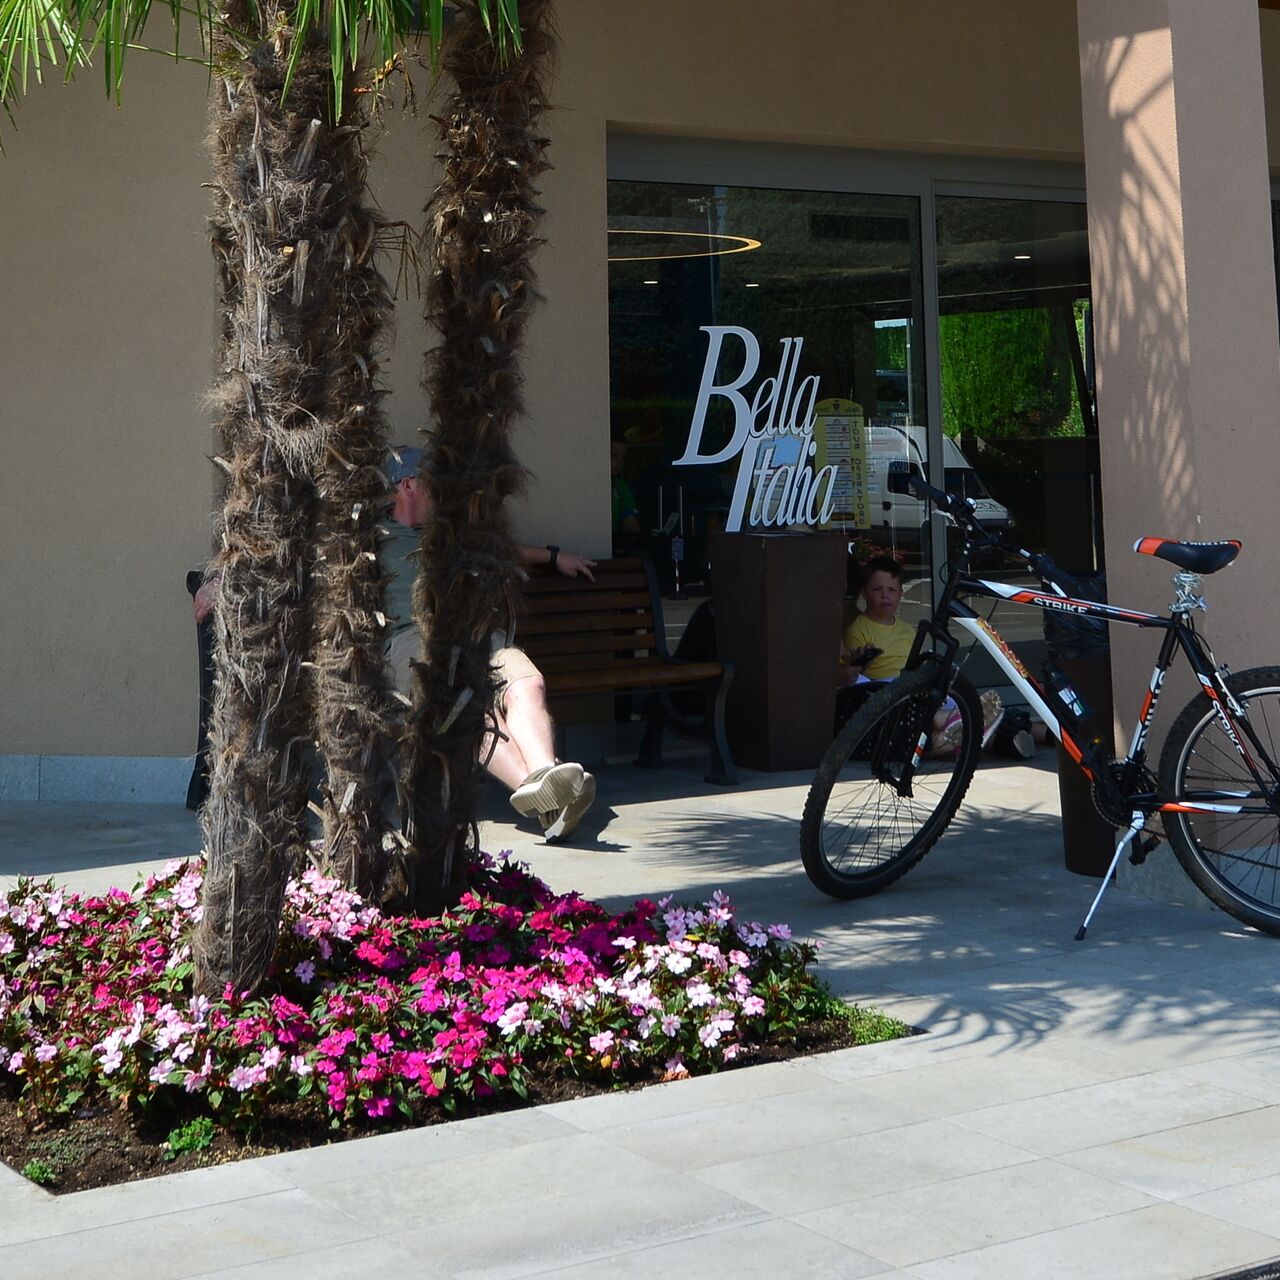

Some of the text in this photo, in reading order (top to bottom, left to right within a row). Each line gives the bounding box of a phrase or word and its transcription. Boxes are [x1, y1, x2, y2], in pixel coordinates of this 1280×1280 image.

[672, 325, 821, 466] Bella
[725, 434, 839, 533] Italia
[1033, 596, 1089, 615] STRIKE
